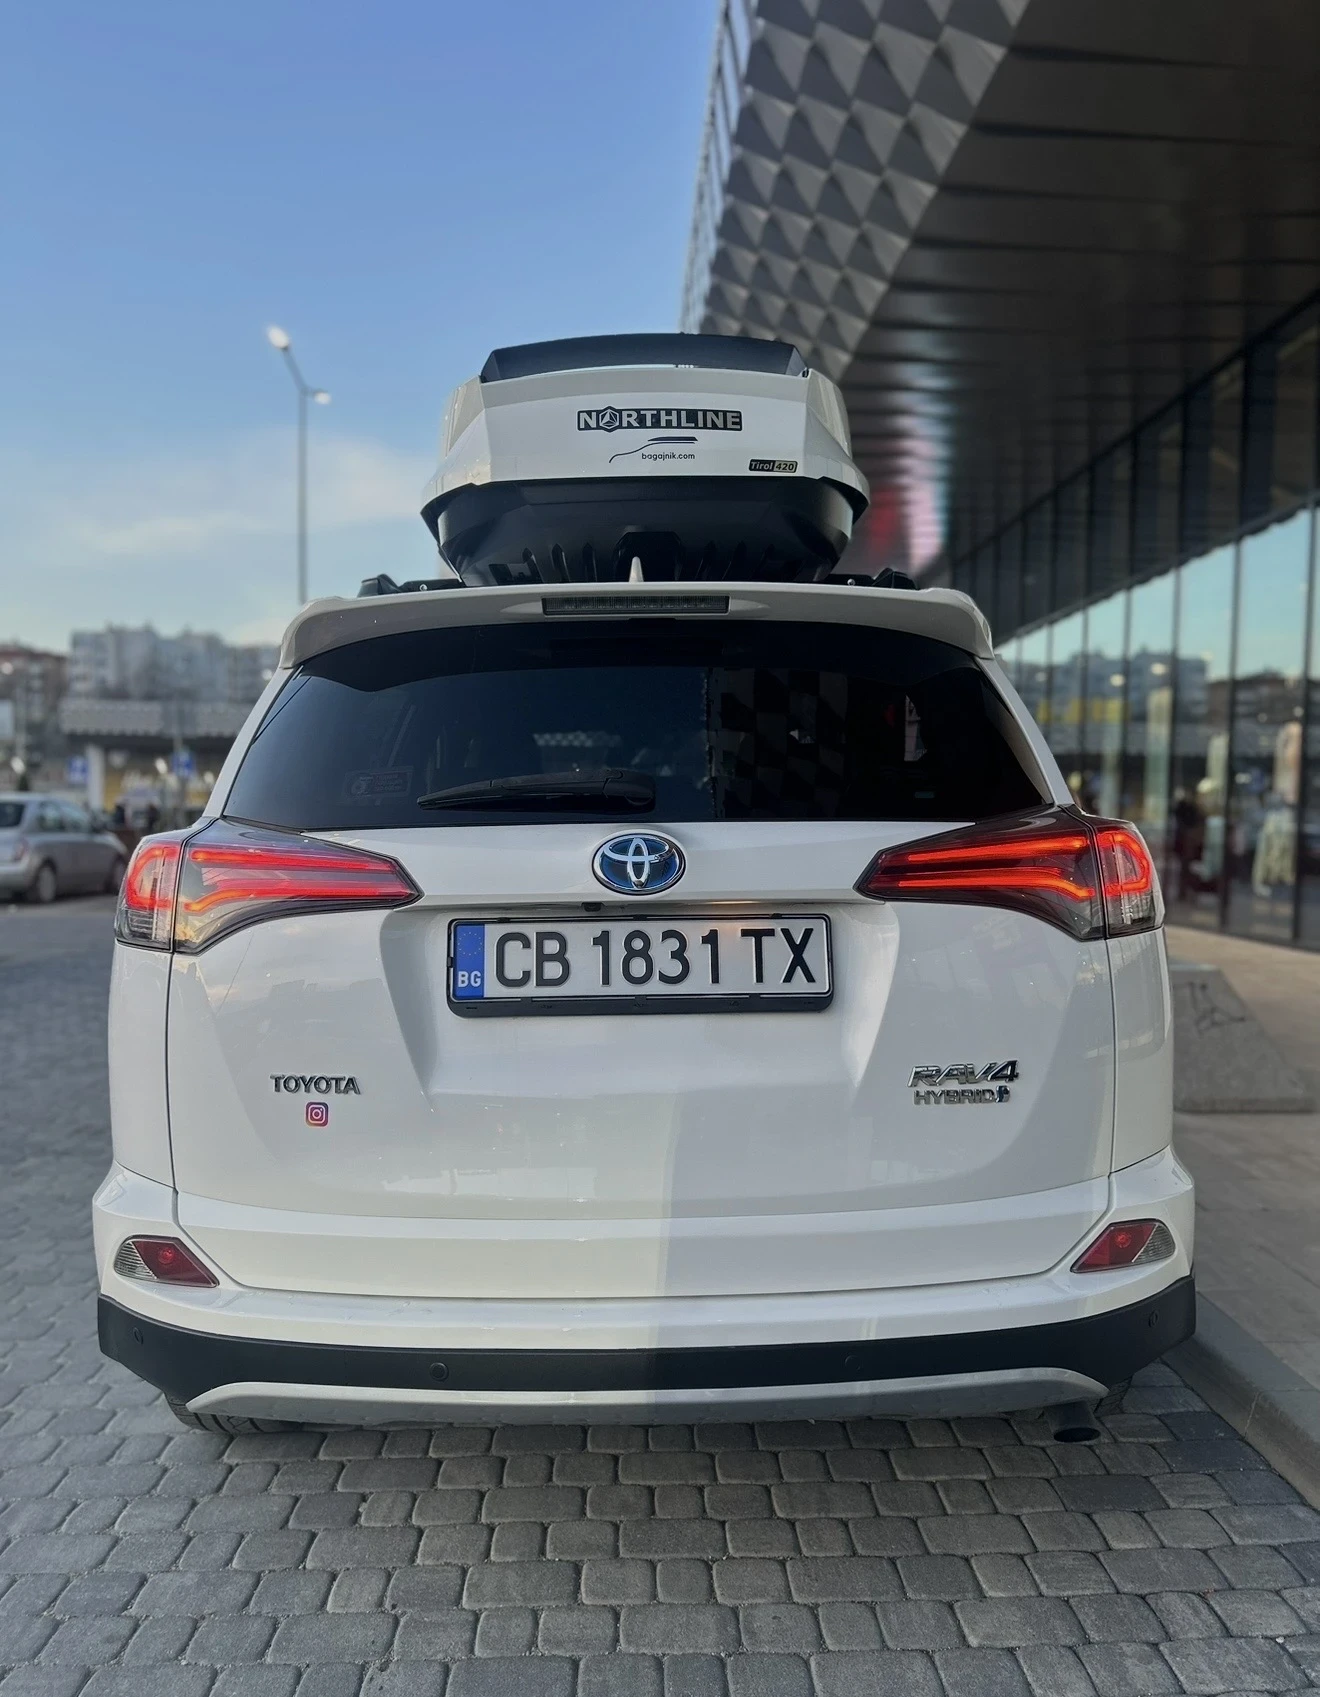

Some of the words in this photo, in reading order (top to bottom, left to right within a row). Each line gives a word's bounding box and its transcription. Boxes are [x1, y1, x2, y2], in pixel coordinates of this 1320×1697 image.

[579, 407, 741, 430] NORTHLINE
[750, 461, 774, 471] Tirol
[775, 462, 796, 472] 420
[495, 931, 570, 988] CB
[591, 929, 721, 986] 1831
[740, 927, 816, 984] TX
[457, 970, 482, 988] BG
[269, 1074, 361, 1095] TOYOTA
[907, 1060, 1019, 1087] RAV4
